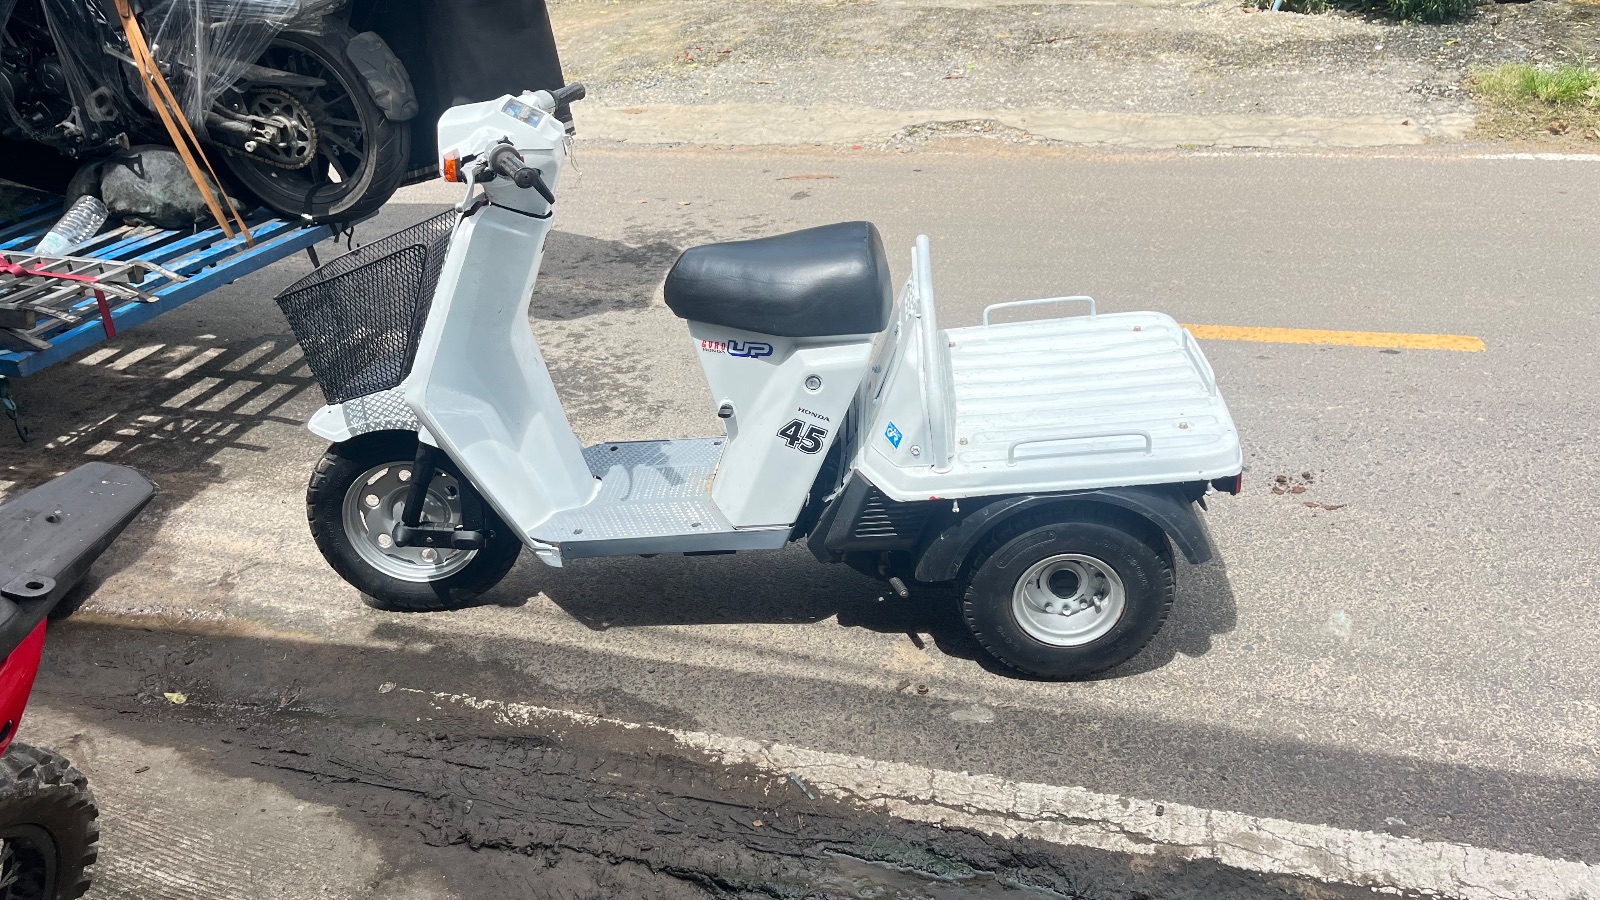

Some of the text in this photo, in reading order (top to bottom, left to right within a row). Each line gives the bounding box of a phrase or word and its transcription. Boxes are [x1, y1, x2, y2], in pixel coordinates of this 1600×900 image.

[727, 340, 773, 358] UP
[798, 406, 830, 422] HONDA
[776, 418, 828, 455] 45
